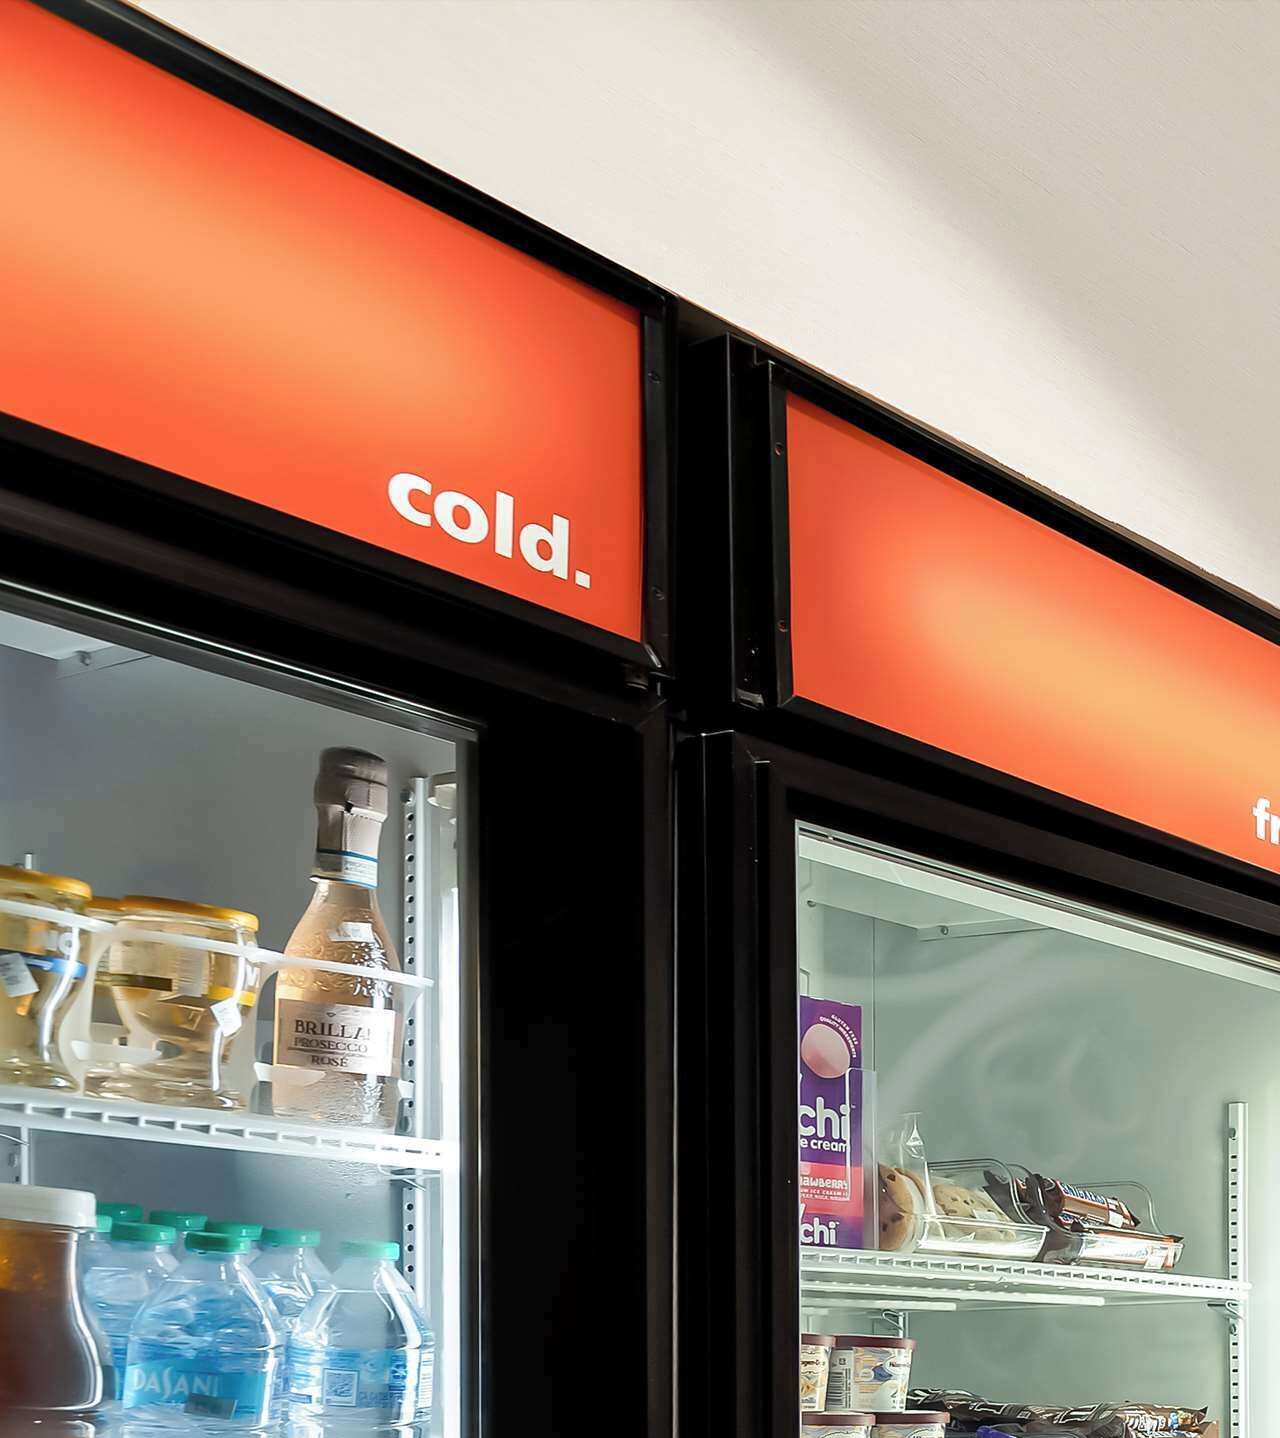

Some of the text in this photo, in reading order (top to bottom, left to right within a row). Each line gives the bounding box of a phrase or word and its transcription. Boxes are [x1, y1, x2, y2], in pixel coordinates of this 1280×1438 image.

[388, 471, 591, 589] cold.
[294, 1036, 369, 1053] PROSECCO
[132, 1366, 220, 1397] DASANI
